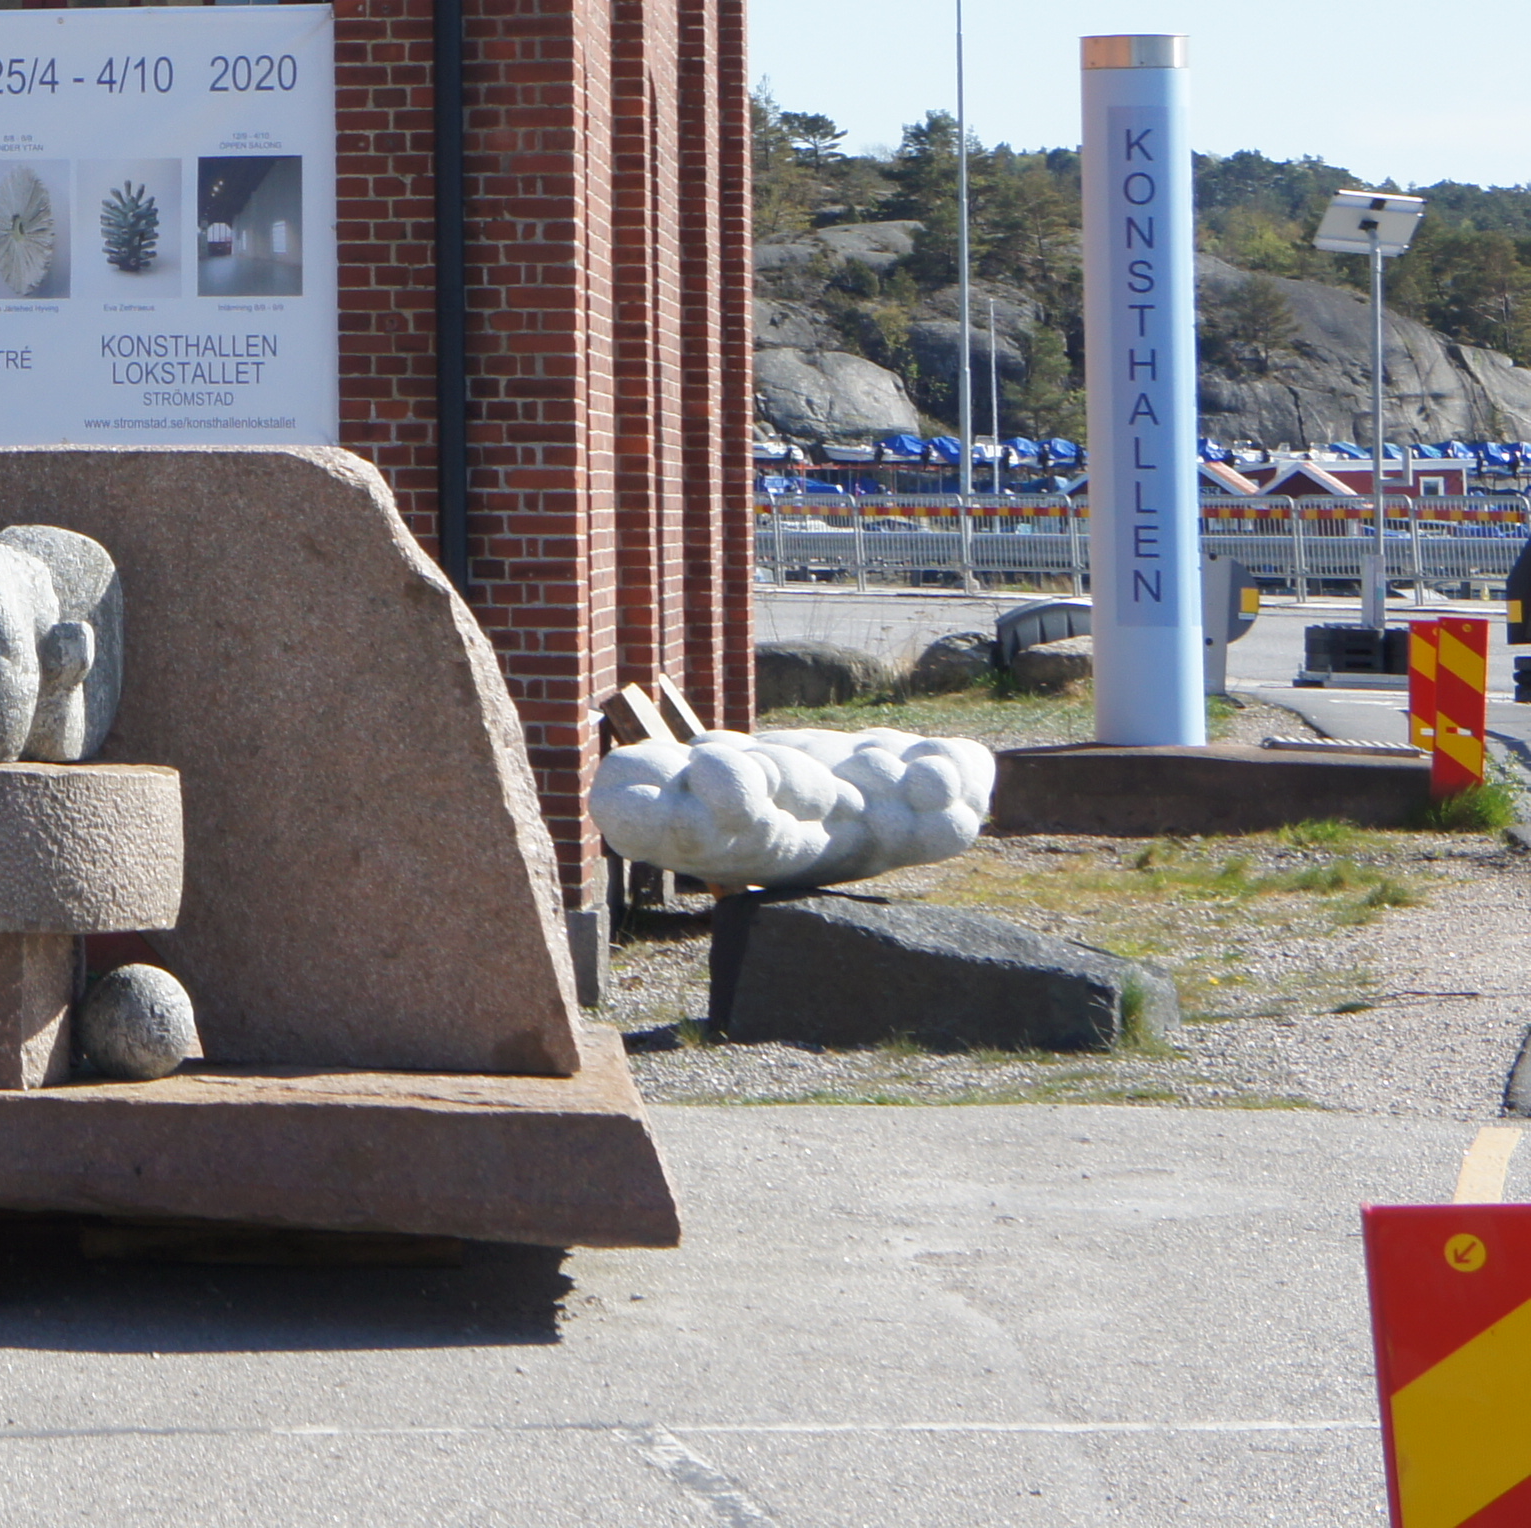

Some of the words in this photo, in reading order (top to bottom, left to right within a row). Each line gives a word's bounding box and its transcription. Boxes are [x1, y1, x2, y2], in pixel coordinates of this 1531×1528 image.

[95, 56, 175, 94] 4/10
[208, 54, 298, 92] 2020
[23, 144, 44, 152] YTAN
[248, 141, 283, 149] SALONG
[100, 334, 278, 358] KONSTHALLEN
[112, 361, 266, 385] LOKSTALLET
[1123, 128, 1162, 603] KONSTHALLEN
[142, 388, 235, 407] STRÖMSTAD
[83, 416, 297, 430] www.stromstad.se/konsthallenlokstallet
